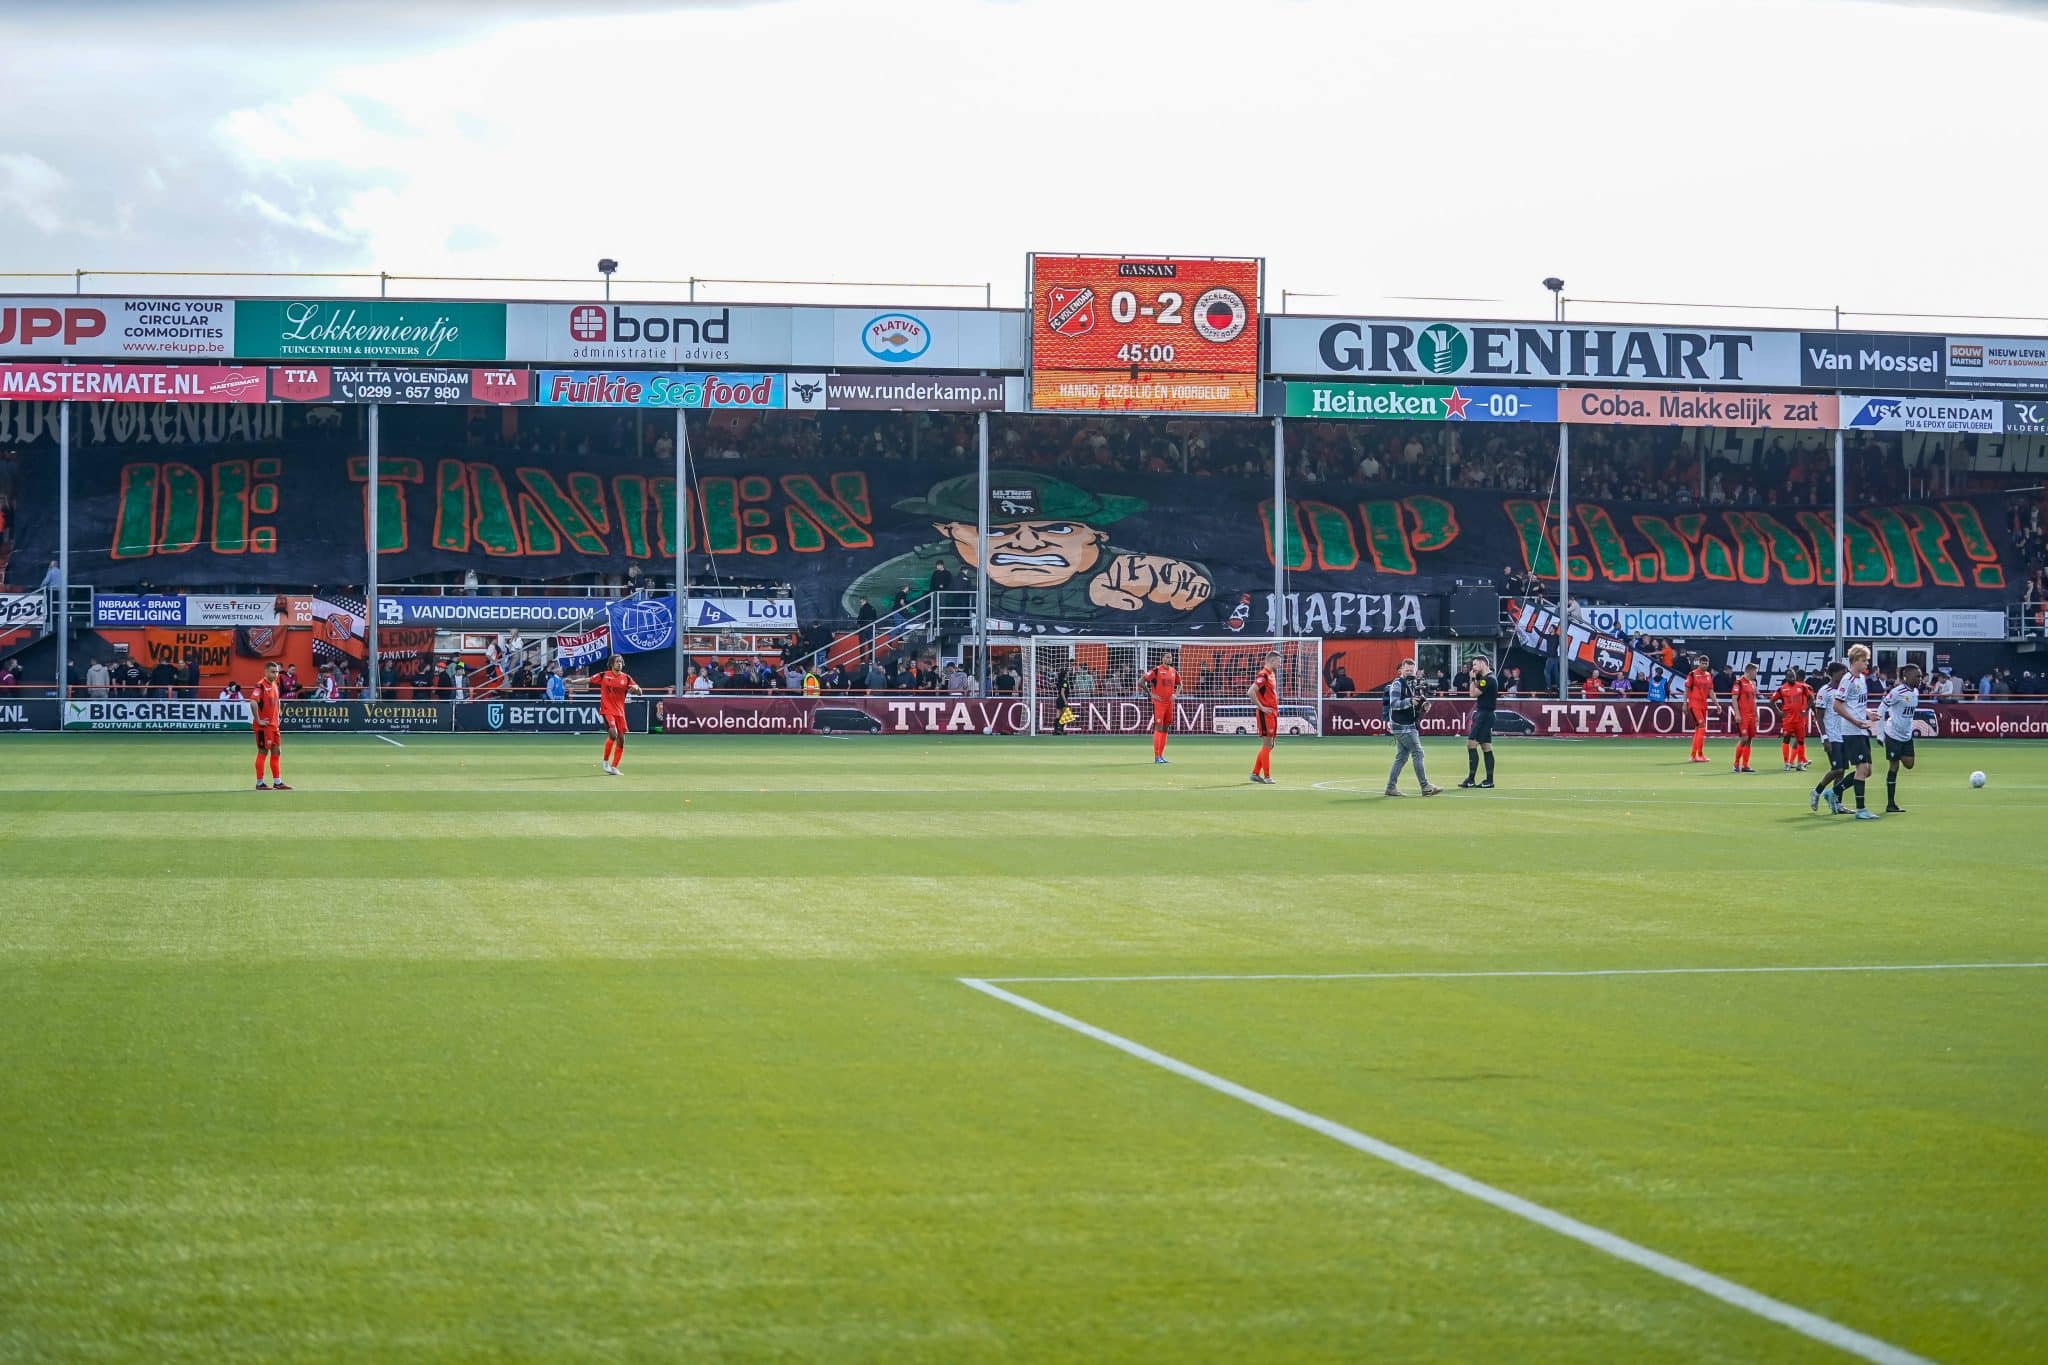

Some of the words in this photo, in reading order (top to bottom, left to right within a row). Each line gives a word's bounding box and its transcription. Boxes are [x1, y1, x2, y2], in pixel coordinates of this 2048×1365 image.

[1120, 264, 1175, 276] GASSAN
[124, 302, 181, 313] MOVING
[186, 302, 223, 313] YOUR
[1059, 289, 1094, 321] VOLENDAM
[139, 314, 209, 326] CIRCULAR
[613, 306, 729, 344] bond
[124, 327, 224, 339] COMMODITIES
[281, 302, 459, 357] Lokkemientje
[872, 320, 921, 336] PLATVIS
[123, 341, 224, 354] www.rekupp.be
[281, 345, 352, 355] TUINCENTRUM
[353, 345, 362, 355] &
[363, 346, 420, 355] HOVENIERS
[573, 347, 667, 360] administratie
[685, 348, 729, 360] advies
[1952, 347, 1982, 356] BOUW
[1988, 348, 2018, 357] NIEUW
[2019, 349, 2046, 358] LEVEN
[1808, 348, 1852, 370] Van
[1859, 350, 1939, 373] Mossel
[1952, 358, 1981, 366] PARTNER
[2, 371, 205, 395] MASTERMATE.NL
[284, 369, 318, 383] TTA
[334, 371, 363, 383] TAXI
[366, 372, 391, 383] TTA
[393, 372, 469, 384] VOLENDAM
[484, 372, 517, 386] TTA
[358, 386, 392, 399] 0299
[405, 386, 431, 399] 657
[434, 387, 460, 399] 980
[550, 374, 643, 404] Fuikie
[827, 382, 1004, 404] www.runderkamp.nl
[1104, 384, 1151, 399] GEZELLIG
[1312, 389, 1438, 415] Heineken
[1581, 392, 1652, 417] Coba.
[1659, 395, 1772, 425] Makkelijk
[1784, 401, 1819, 422] zat
[1867, 404, 1902, 419] VSK
[1905, 405, 1993, 421] VOLENDAM
[1923, 420, 1945, 429] EPOXY
[110, 459, 282, 560] DE
[99, 600, 140, 609] INBRAAK
[148, 600, 181, 609] BRAND
[203, 602, 261, 611] WESTEND
[748, 600, 793, 618] Lou
[98, 609, 182, 621] BEVEILIGING
[202, 613, 265, 621] WWW.WESTEND.NL
[411, 605, 594, 620] VANDONGEDEROO.COM
[706, 607, 721, 622] LB
[1625, 609, 1734, 637] plaatwerk
[1845, 616, 1938, 637] INBUCO
[176, 632, 209, 645] HUP
[147, 640, 230, 667] VOLENDAM
[1726, 650, 1826, 673] ULTRAS
[90, 703, 249, 721] BIG-GREEN.NL
[363, 703, 438, 718] Veerman
[509, 706, 604, 725] BETCITY.N
[888, 702, 976, 731] TTA
[978, 702, 1205, 731] VOLENDM
[91, 721, 142, 729] ZOUTVRIJE
[145, 721, 221, 729] KALKPREVENTIE
[665, 710, 809, 729] tta-volendam.nl
[1541, 705, 1623, 733] TTA
